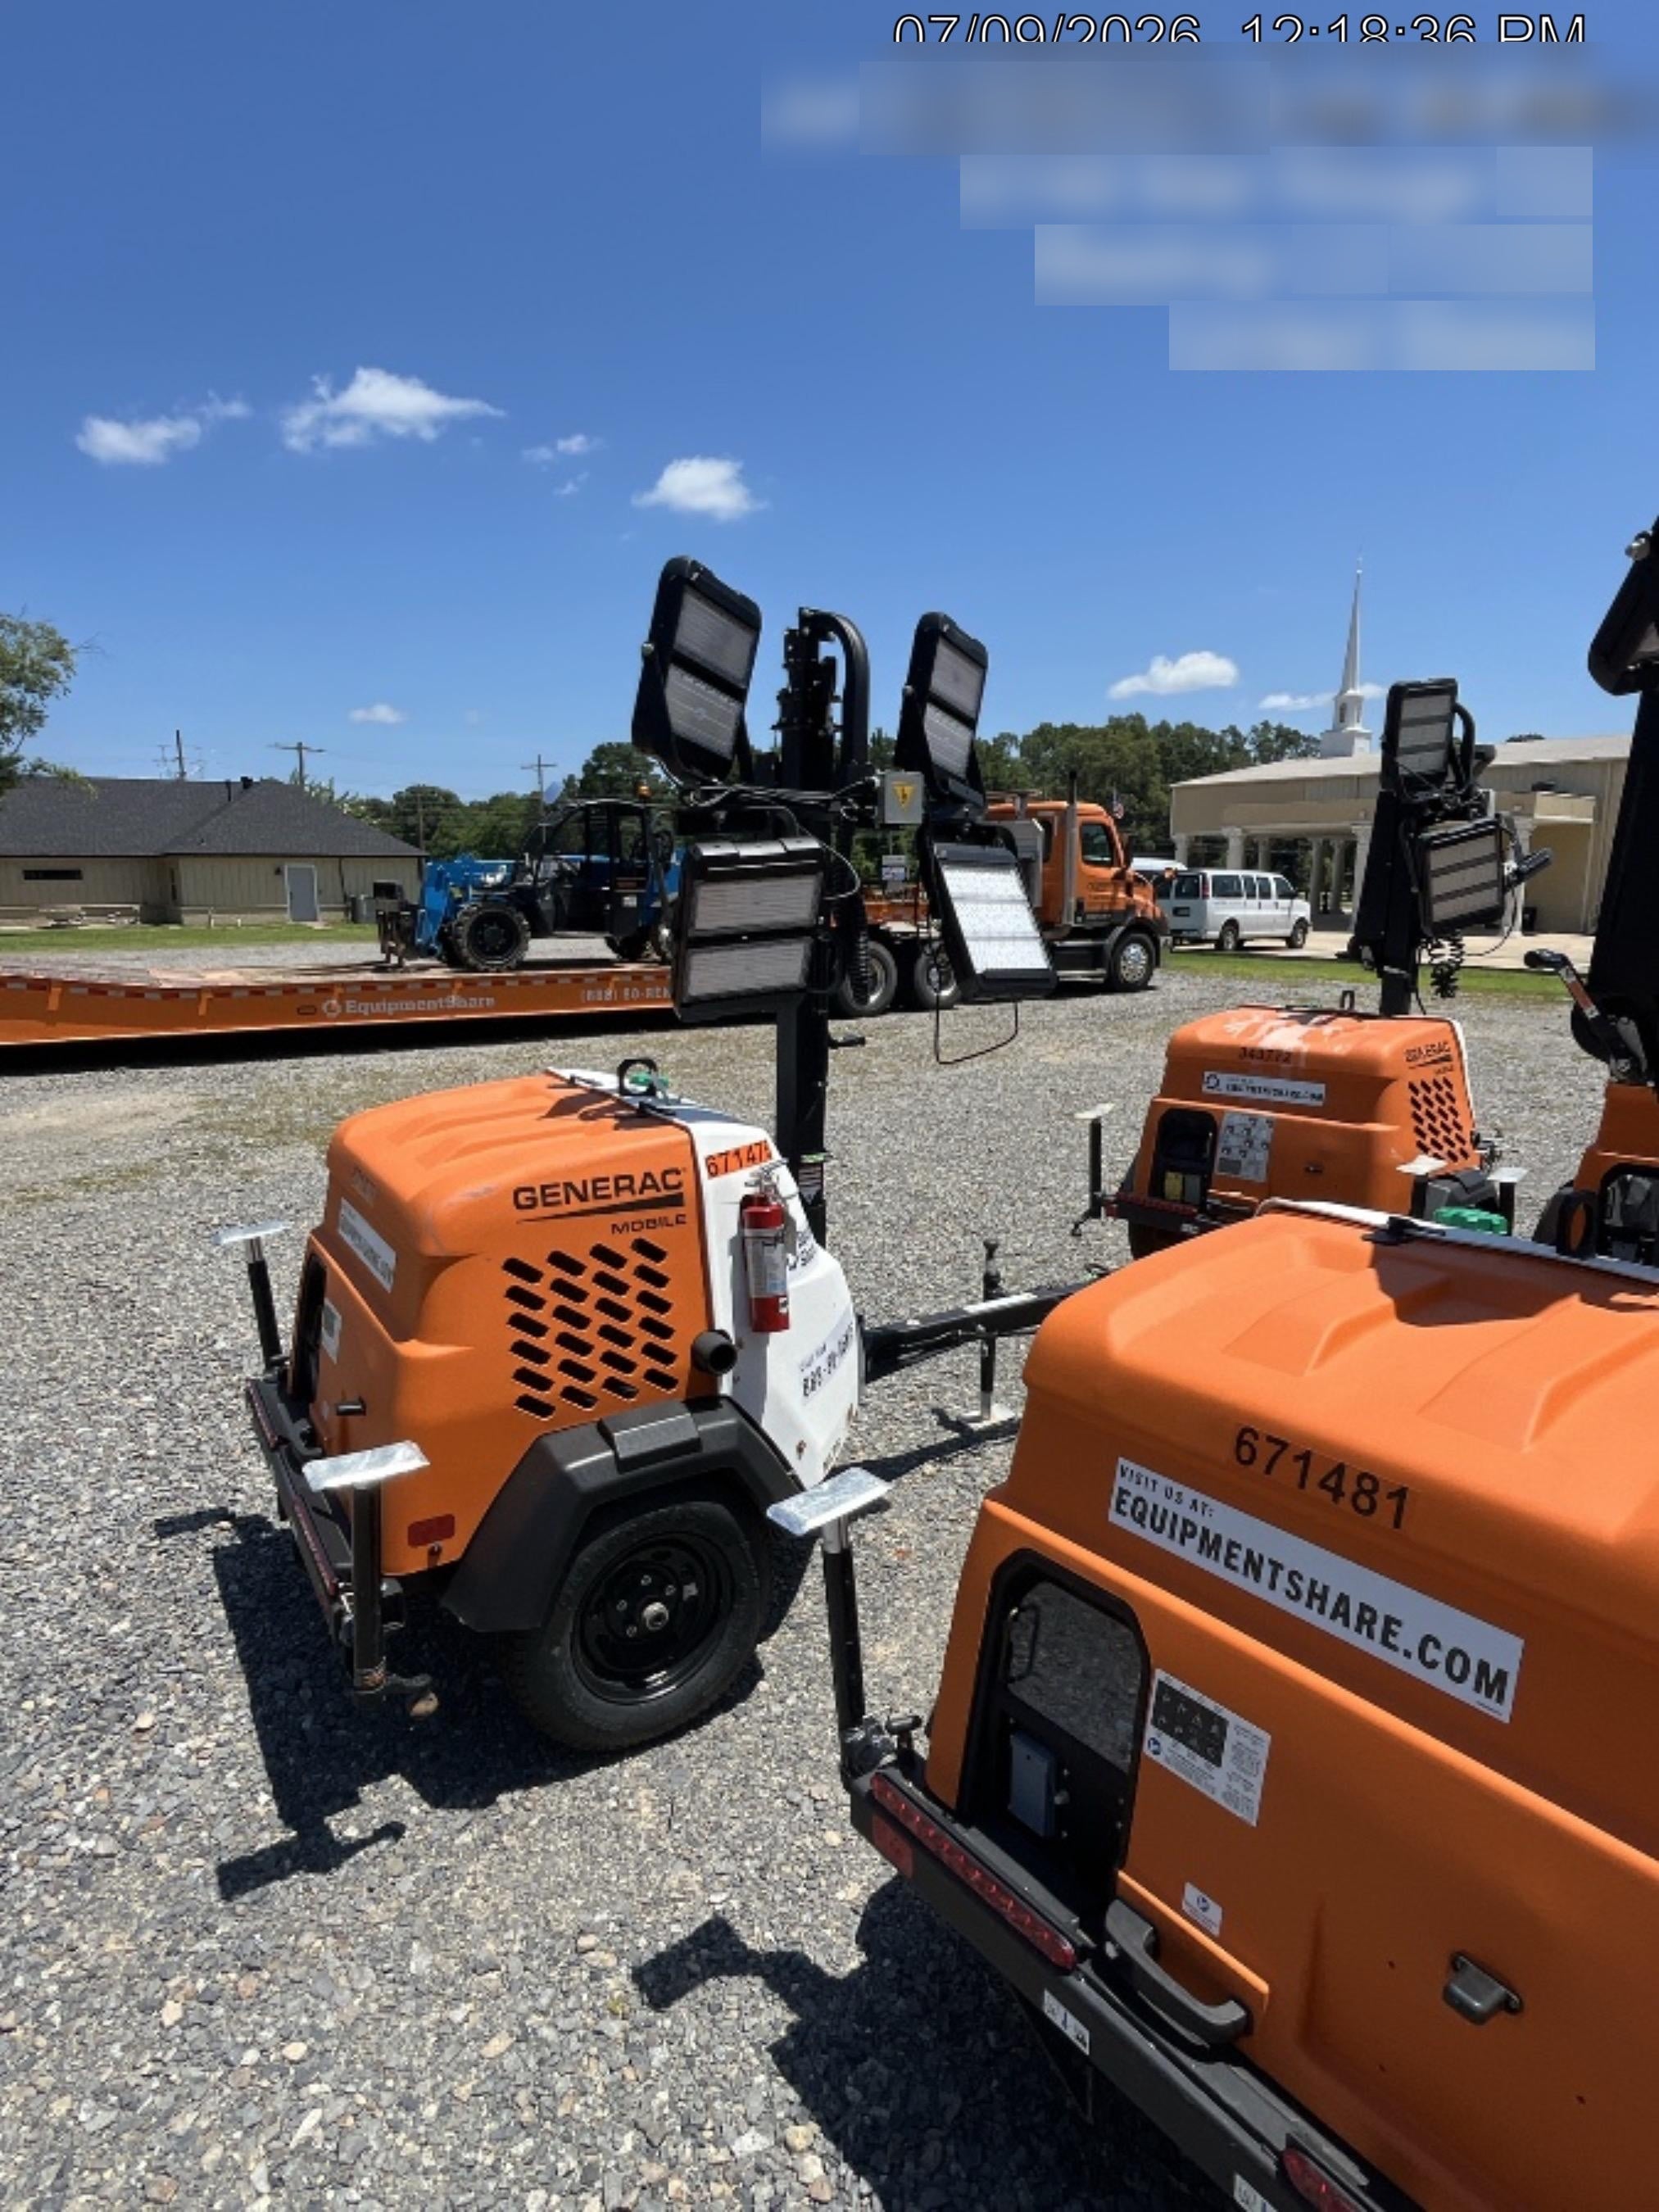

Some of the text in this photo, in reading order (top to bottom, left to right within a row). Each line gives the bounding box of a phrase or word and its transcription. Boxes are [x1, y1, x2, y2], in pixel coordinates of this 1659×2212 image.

[513, 1167, 684, 1210] GENERAC
[611, 1214, 687, 1235] MOBILE
[1119, 1463, 1159, 1494] VISIT
[1164, 1485, 1184, 1505] US
[1235, 1426, 1409, 1530] 671481
[1114, 1487, 1509, 1707] EQUIPMENTSHARE.COM
